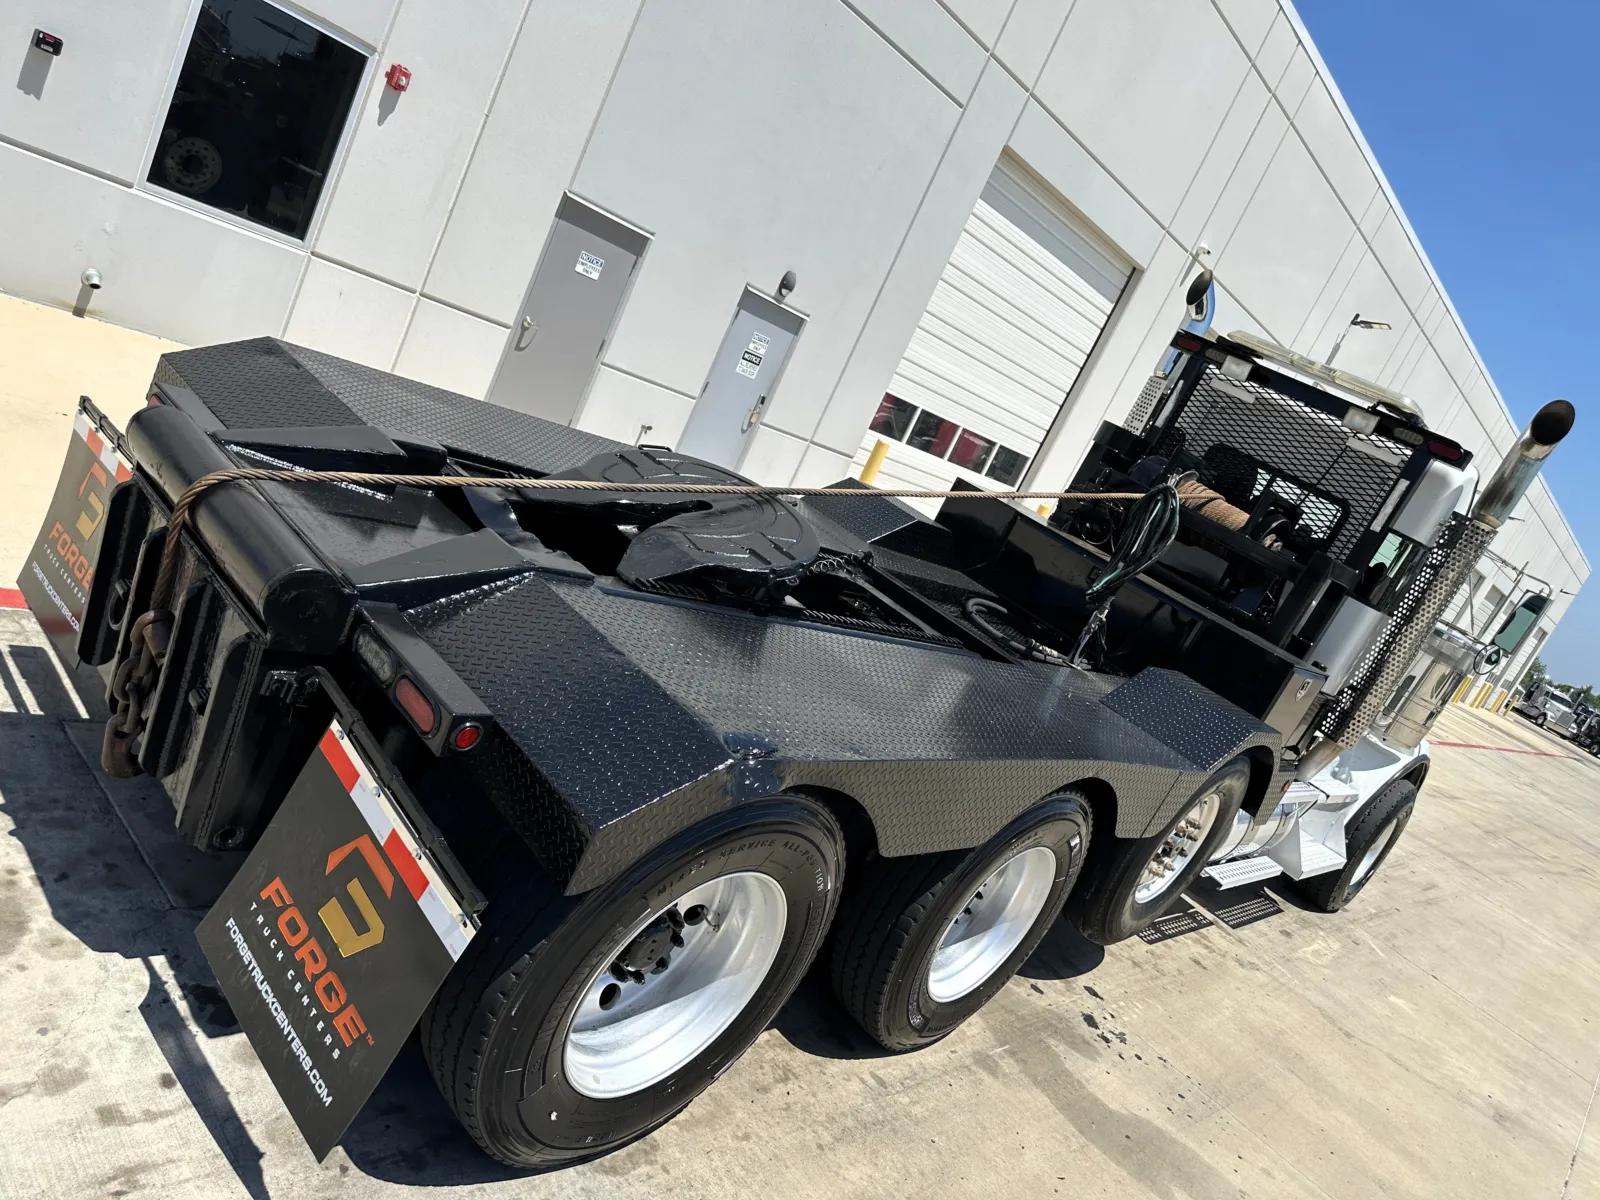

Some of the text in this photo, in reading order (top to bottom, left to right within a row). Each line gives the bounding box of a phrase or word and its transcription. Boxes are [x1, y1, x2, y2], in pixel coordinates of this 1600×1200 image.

[48, 520, 94, 592] FORGE
[225, 916, 333, 1107] FORGETRUCKCENTERS.COM
[251, 902, 341, 1060] TRUCK CENTERS
[259, 876, 367, 1047] FORGE
